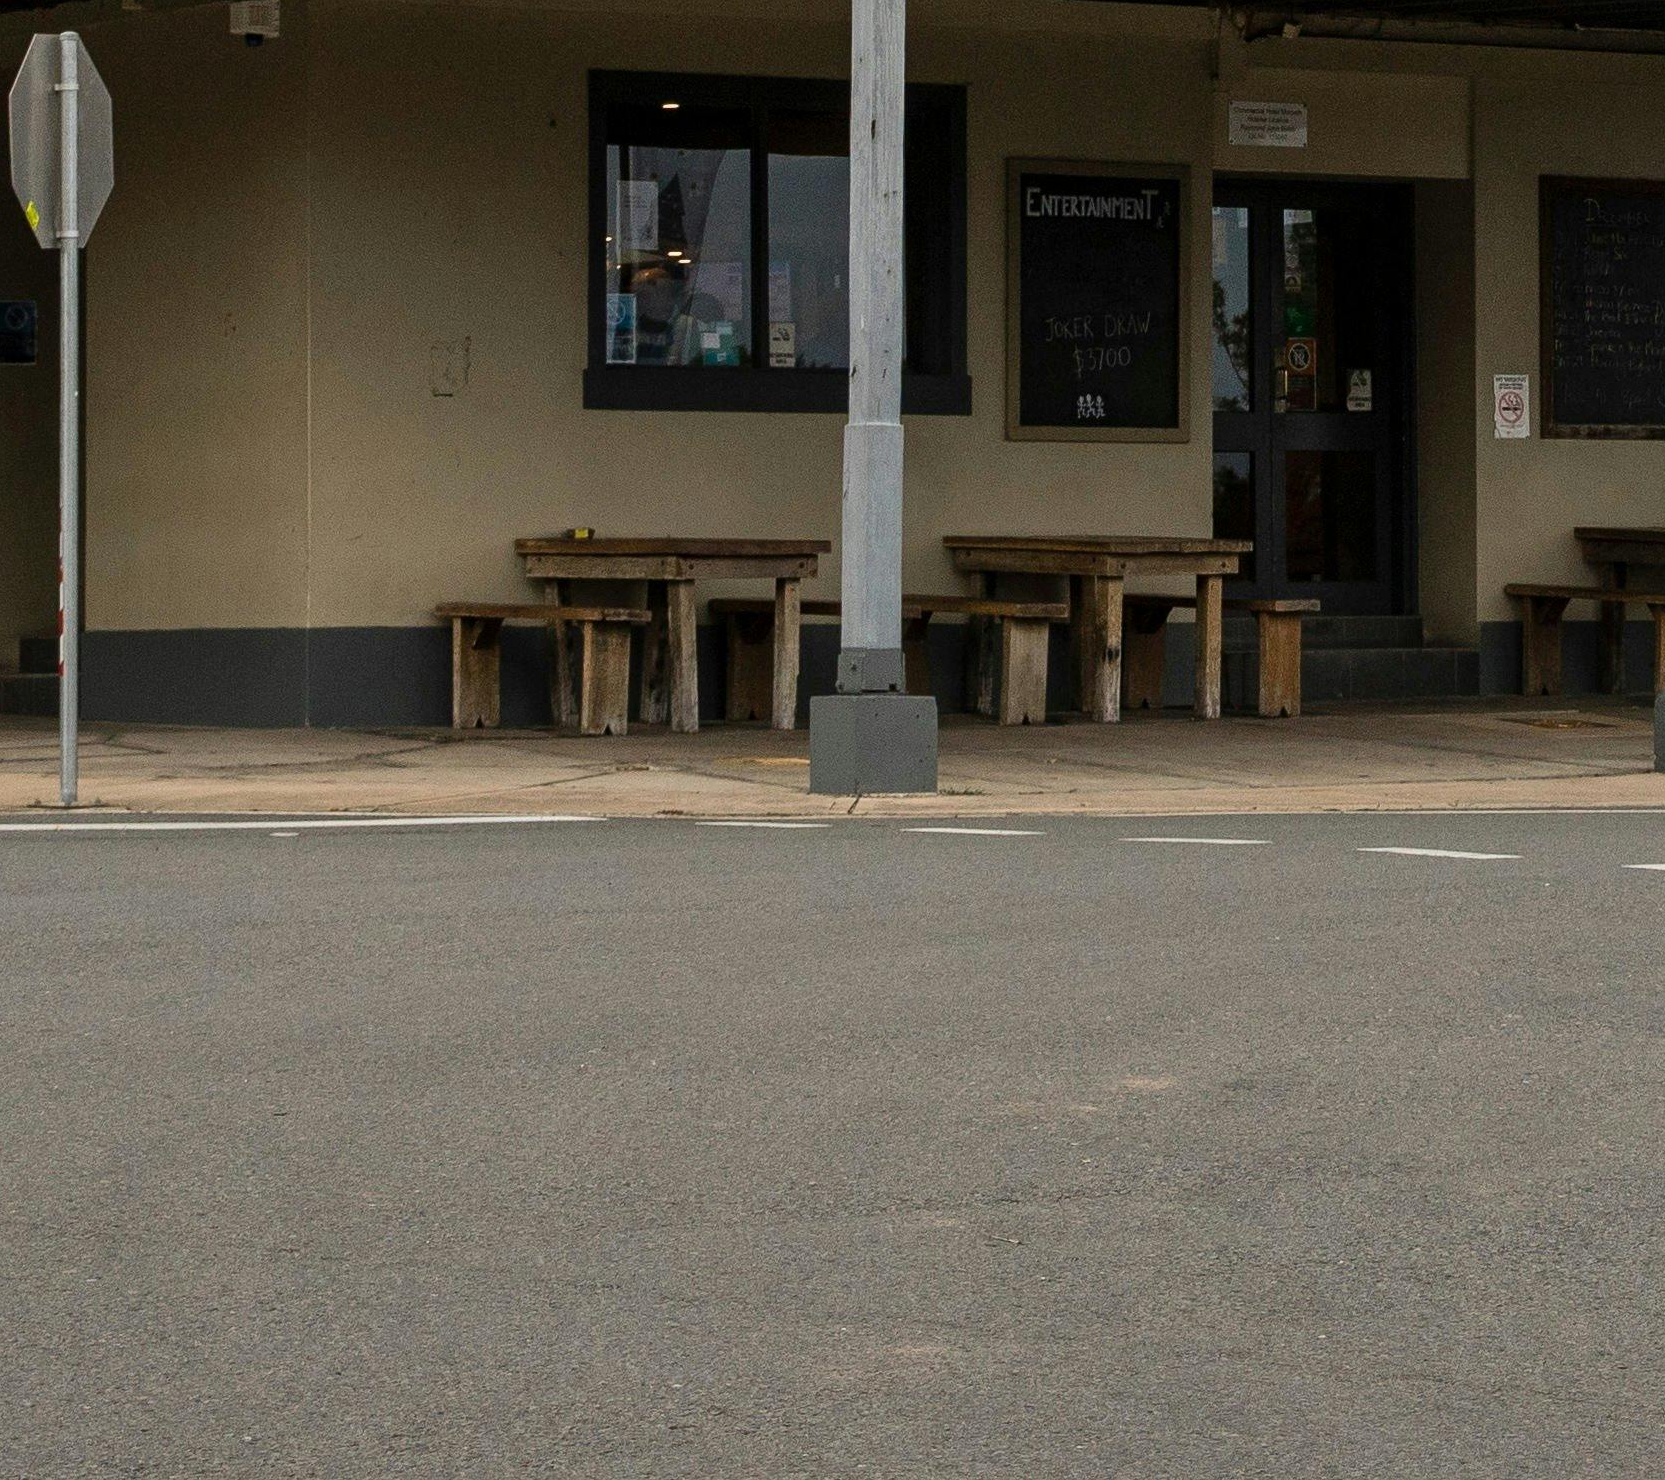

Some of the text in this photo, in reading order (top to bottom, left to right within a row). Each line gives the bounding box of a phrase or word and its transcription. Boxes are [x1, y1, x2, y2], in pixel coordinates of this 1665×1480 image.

[1025, 186, 1160, 221] ENTERTAINMENT
[1044, 311, 1152, 343] JOKER DRAW
[1072, 344, 1133, 380] $3700
